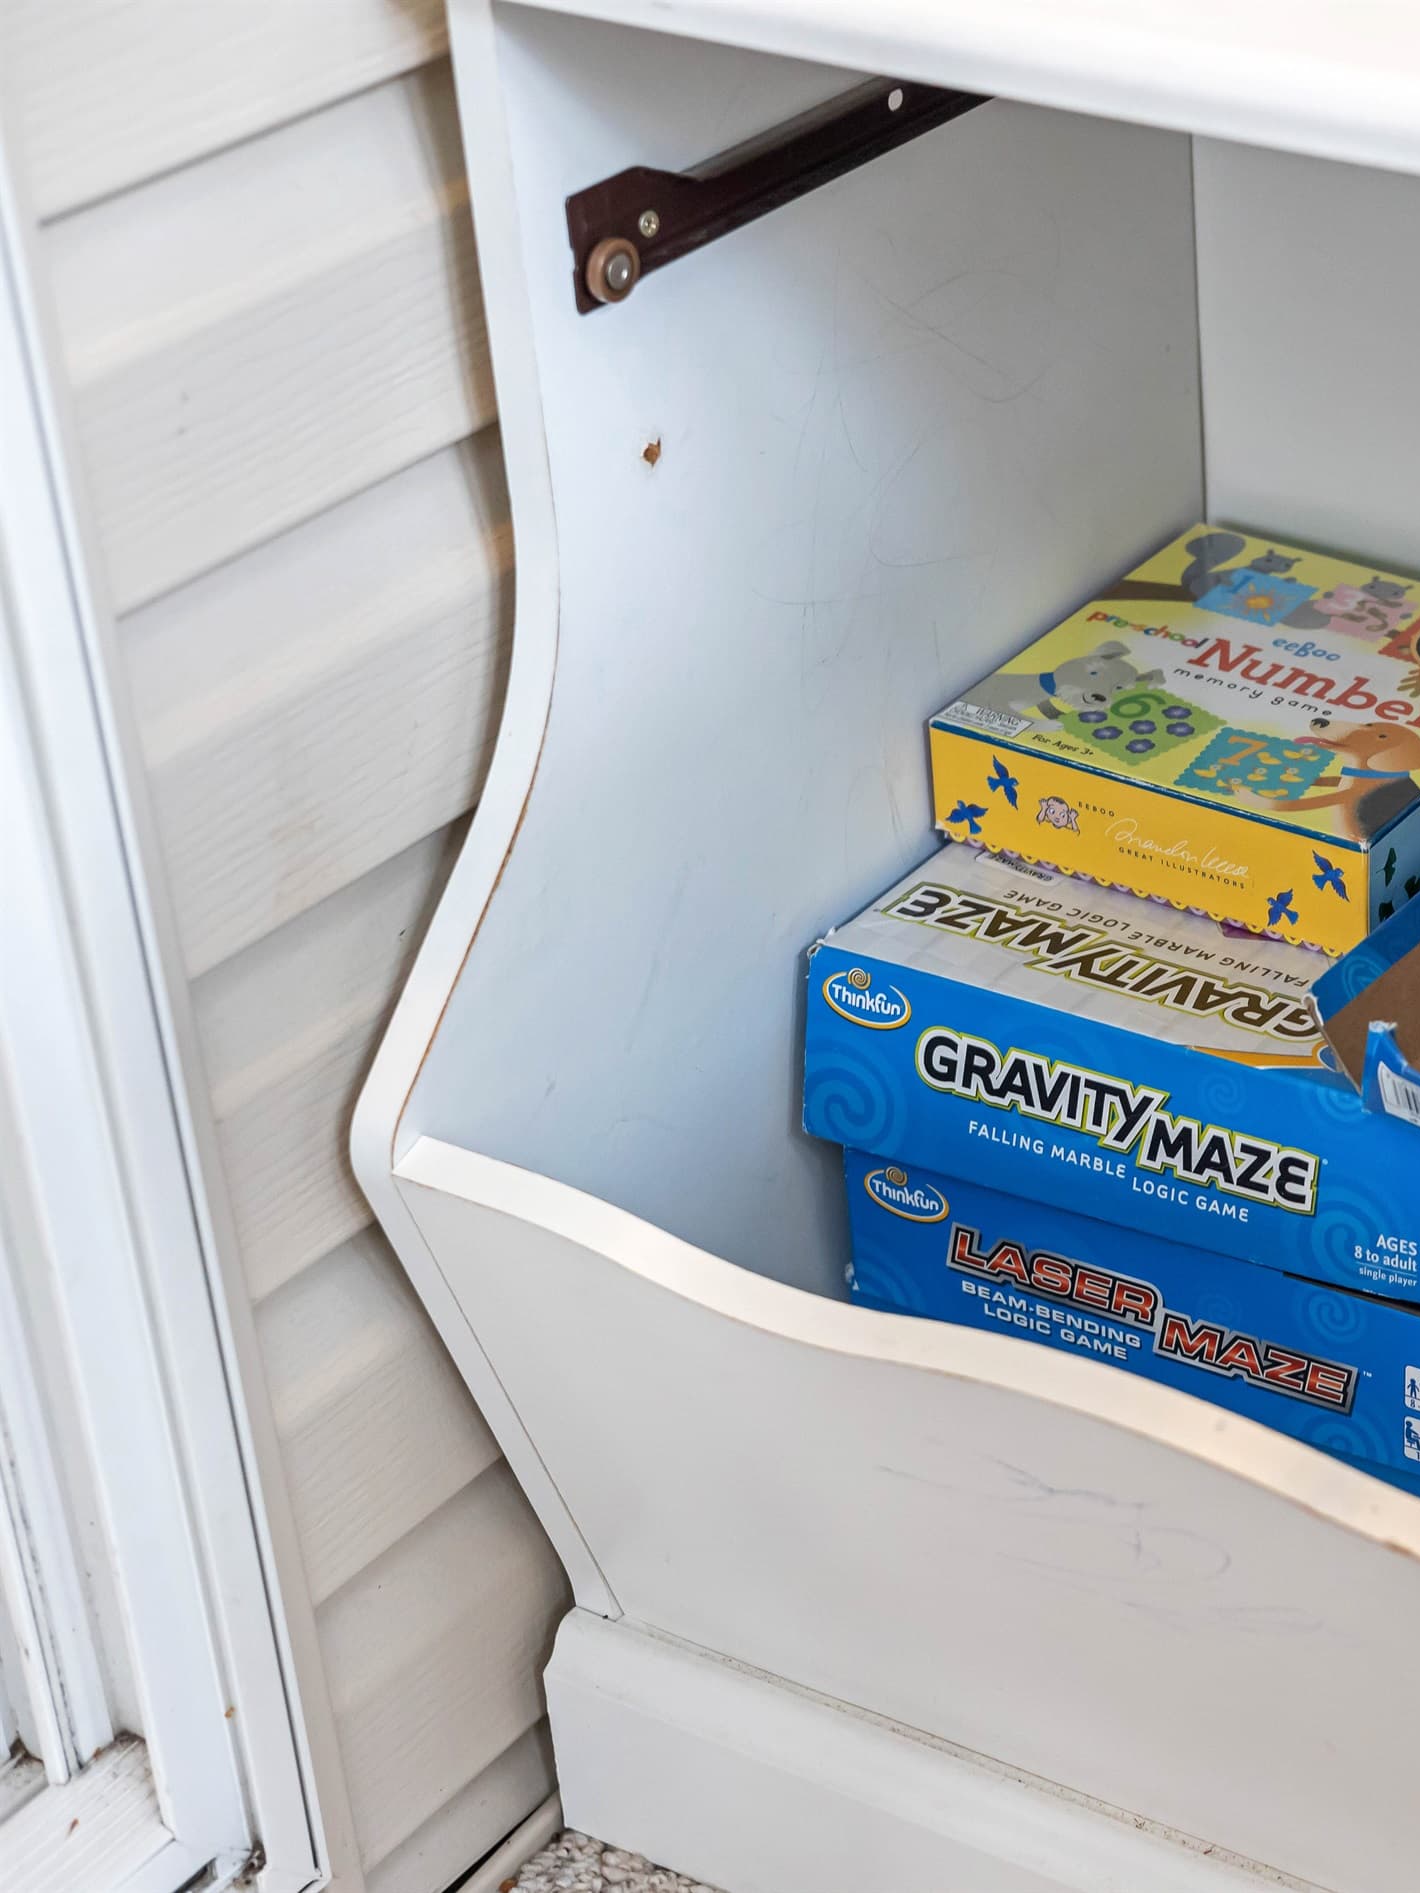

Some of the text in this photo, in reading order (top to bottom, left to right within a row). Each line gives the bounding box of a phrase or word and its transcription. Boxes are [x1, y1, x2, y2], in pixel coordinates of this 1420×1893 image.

[1110, 693, 1166, 719] 6
[1173, 668, 1332, 717] memory game
[1032, 733, 1052, 744] For
[1053, 738, 1079, 752] Ages
[1219, 736, 1269, 766] 7
[1078, 801, 1115, 817] EEBOO
[1118, 846, 1246, 890] GREAT ILLUSTRATORS
[900, 889, 1090, 956] MAZE
[1003, 889, 1310, 988] FALLING MARBLE LOGIC GAME
[921, 1033, 1156, 1143] GRAVITY
[1146, 1118, 1310, 1205] MAZE
[968, 1121, 1249, 1223] FALLING MARBLE LOGIC GAME
[1354, 1245, 1417, 1272] 8 to adult
[1376, 1234, 1418, 1256] AGES
[1359, 1266, 1418, 1287] single player
[952, 1228, 1350, 1405] LASER MAZE
[961, 1279, 1142, 1349] BEAM-BENDING
[983, 1305, 1128, 1361] LOGIC GAME
